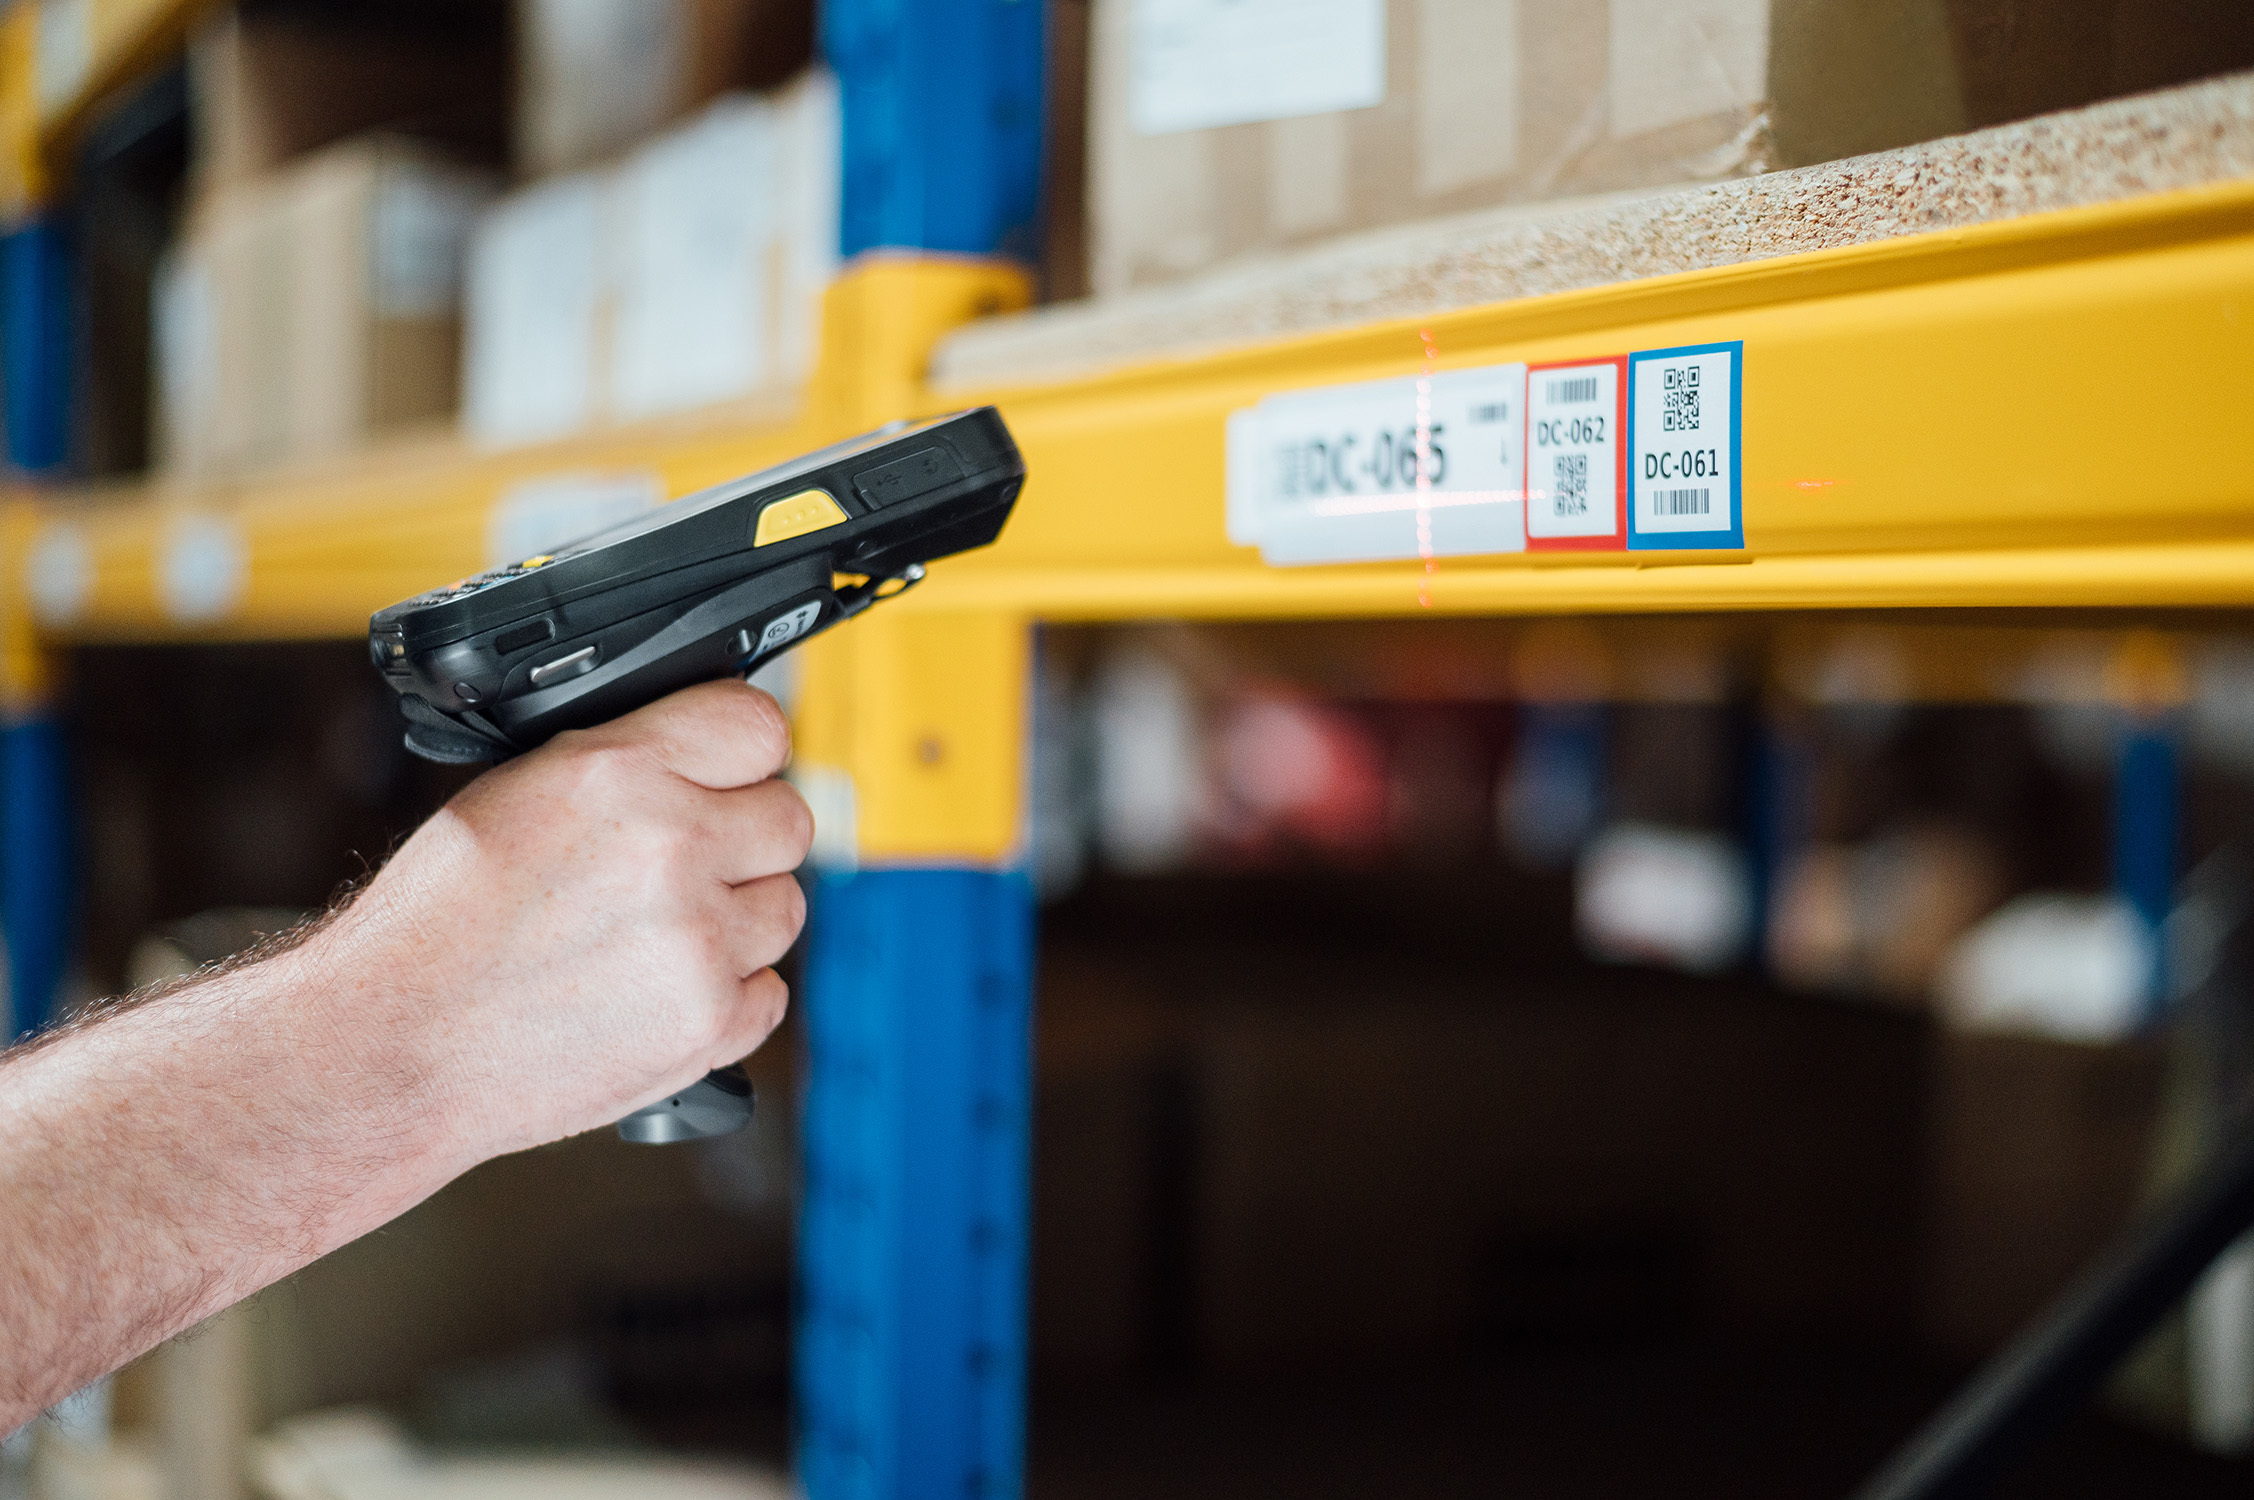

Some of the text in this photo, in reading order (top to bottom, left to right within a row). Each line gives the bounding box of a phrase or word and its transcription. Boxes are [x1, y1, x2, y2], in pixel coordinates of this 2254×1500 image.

[1537, 416, 1605, 446] DC-062
[1306, 423, 1448, 494] DC-065
[1644, 448, 1719, 480] DC-061
